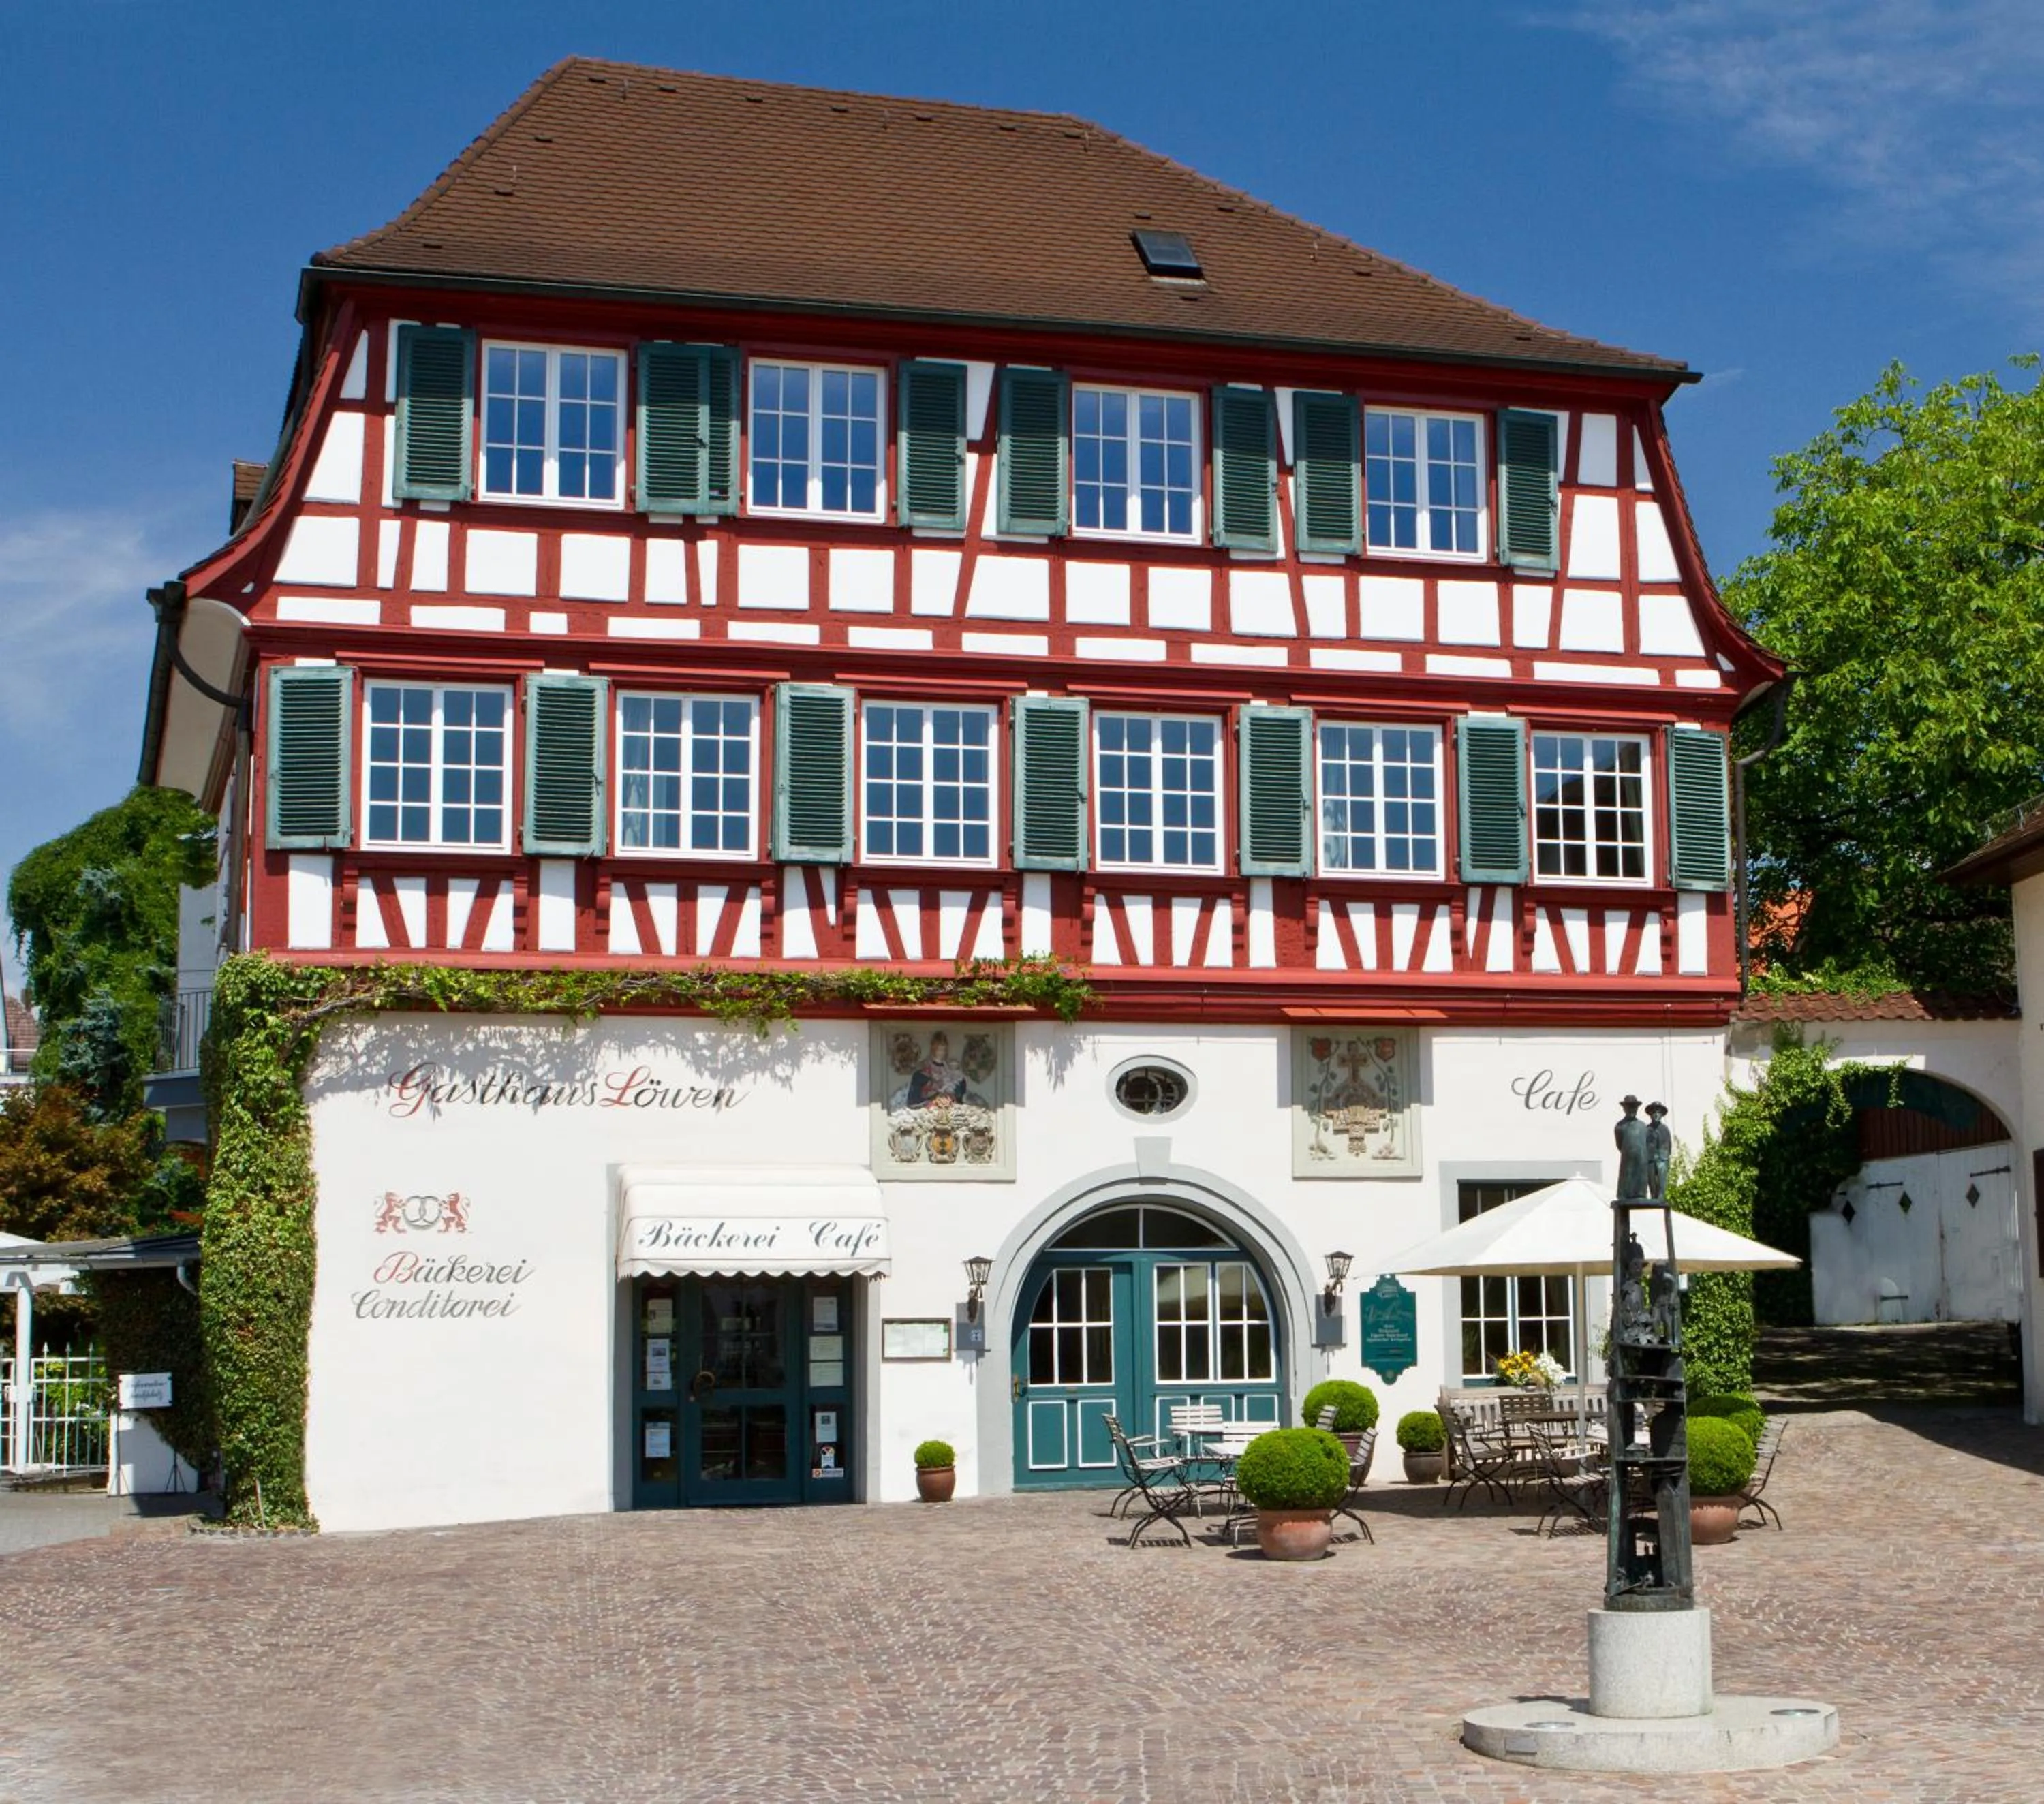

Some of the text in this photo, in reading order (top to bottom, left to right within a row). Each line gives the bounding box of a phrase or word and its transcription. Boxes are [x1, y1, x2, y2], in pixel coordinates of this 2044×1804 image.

[388, 1062, 749, 1117] Gasthaus Löwen
[638, 1219, 780, 1247] Bäckerei
[373, 1251, 535, 1284] Bäckerei
[350, 1289, 521, 1319] Conditorei
